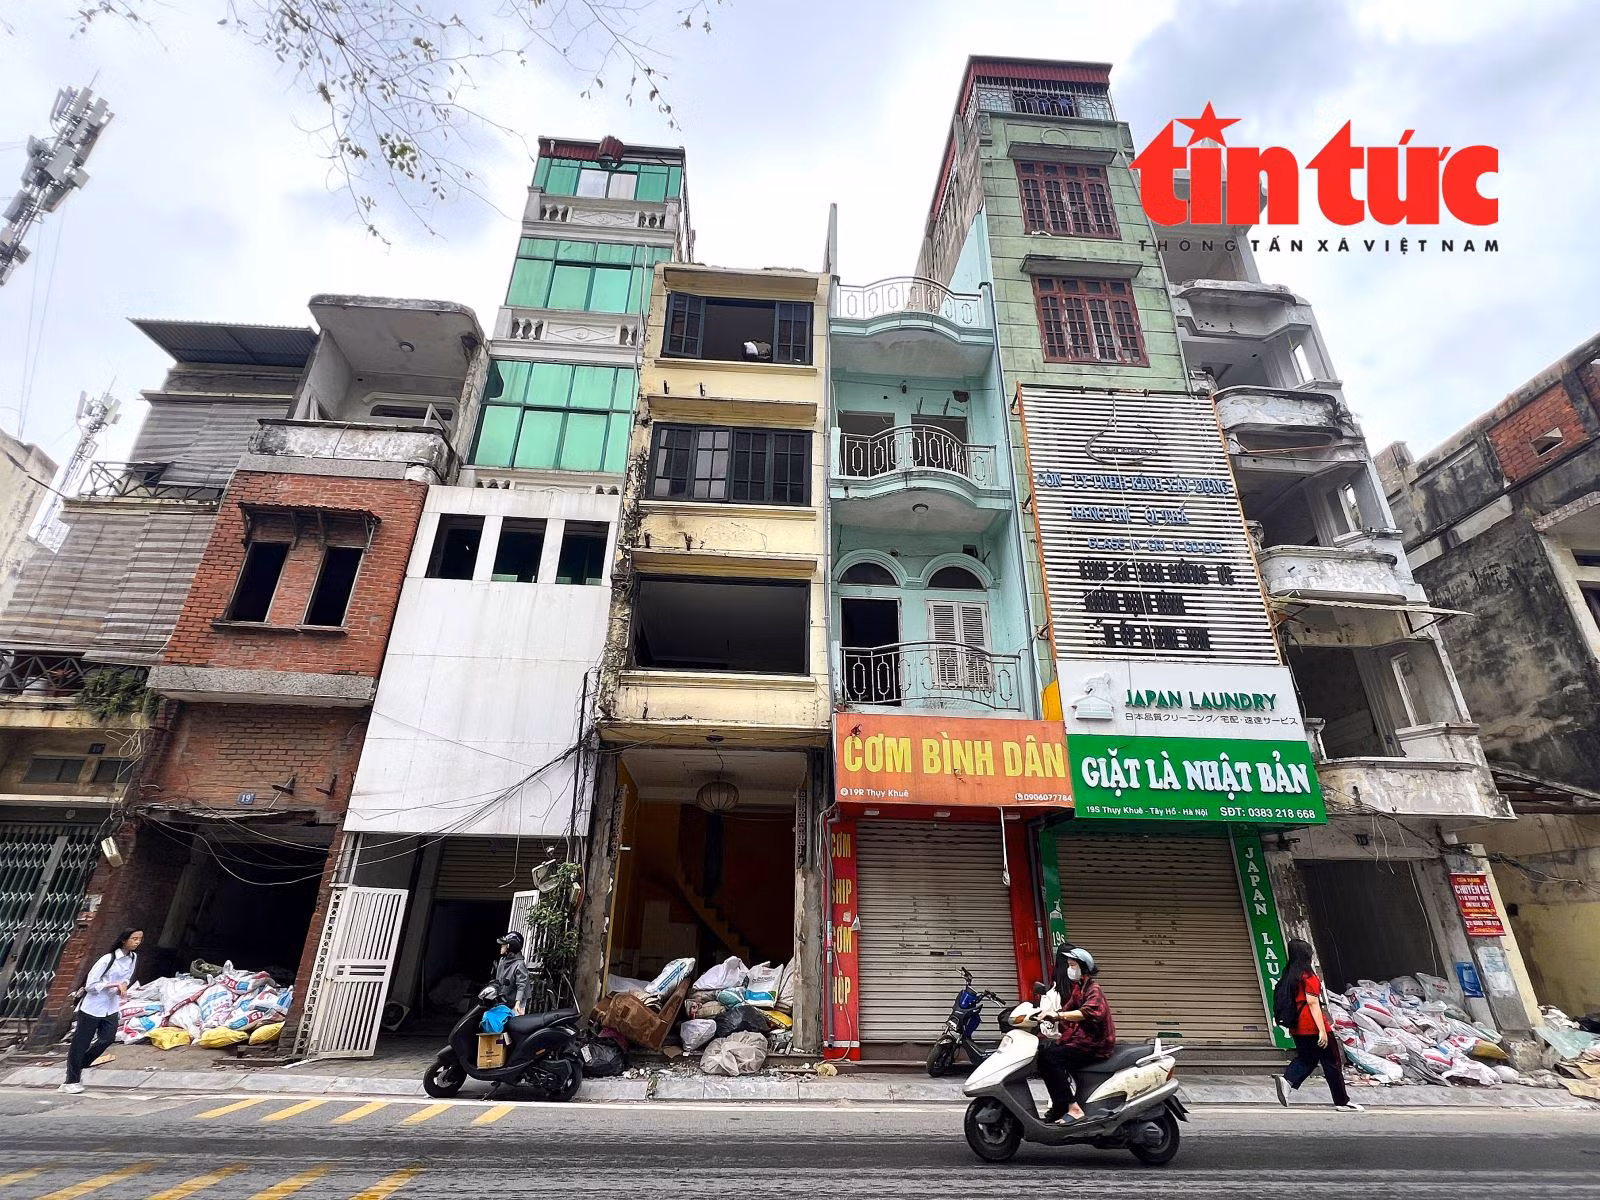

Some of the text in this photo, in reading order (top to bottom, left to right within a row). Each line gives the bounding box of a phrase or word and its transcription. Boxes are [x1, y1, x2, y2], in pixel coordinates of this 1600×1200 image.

[1072, 474, 1088, 488] TY
[1091, 474, 1128, 490] TNHH
[1087, 537, 1125, 549] GLASS
[1125, 689, 1277, 711] JAPAN LAUNDRY
[843, 731, 1066, 778] CƠM BÌNH DÂN
[1081, 747, 1311, 800] GIẶT LÀ NHẬT BẢN
[849, 788, 909, 797] 19R Thụy Khuê
[1102, 806, 1122, 816] Thụy
[1123, 806, 1143, 814] Khuê
[1149, 807, 1164, 817] Tây
[1182, 807, 1194, 816] Hà
[1194, 807, 1208, 817] Nội
[1219, 806, 1315, 819] SĐT: 0383 218 668
[1245, 847, 1267, 916] JAPAN
